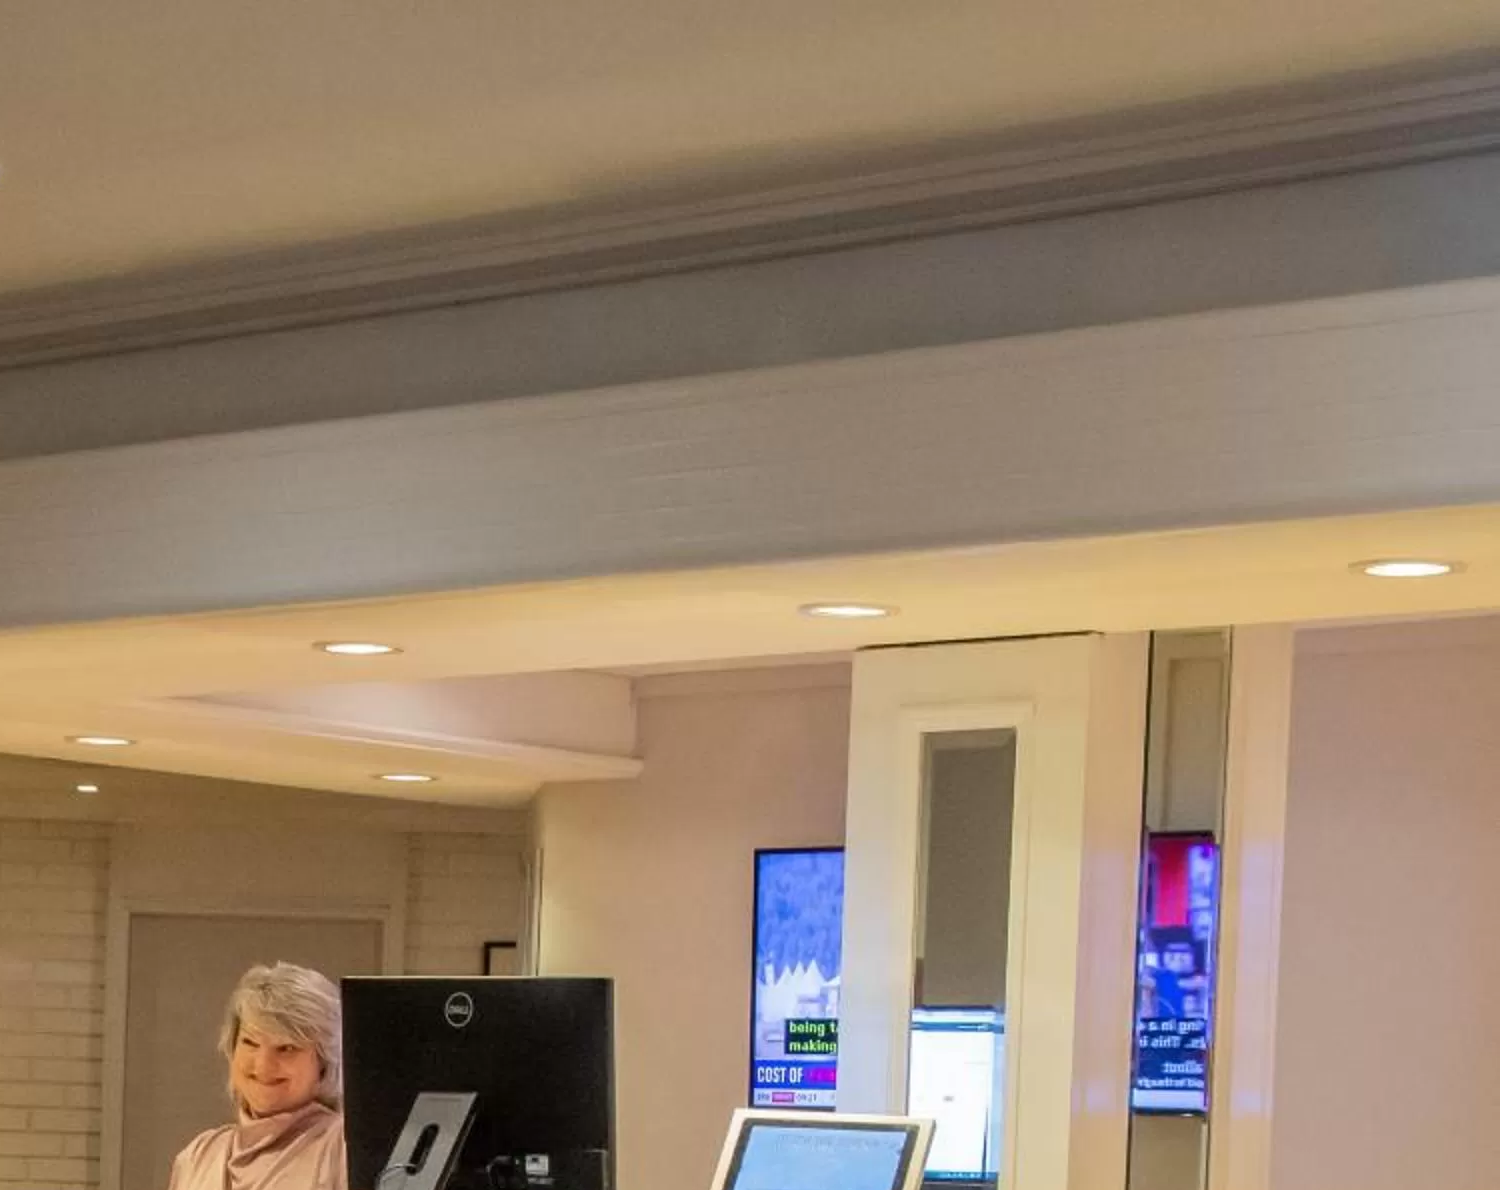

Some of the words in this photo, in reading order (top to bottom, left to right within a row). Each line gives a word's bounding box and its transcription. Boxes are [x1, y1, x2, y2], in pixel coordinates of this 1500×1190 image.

[789, 1021, 825, 1037] being
[757, 1066, 786, 1083] COST
[789, 1066, 804, 1084] OF
